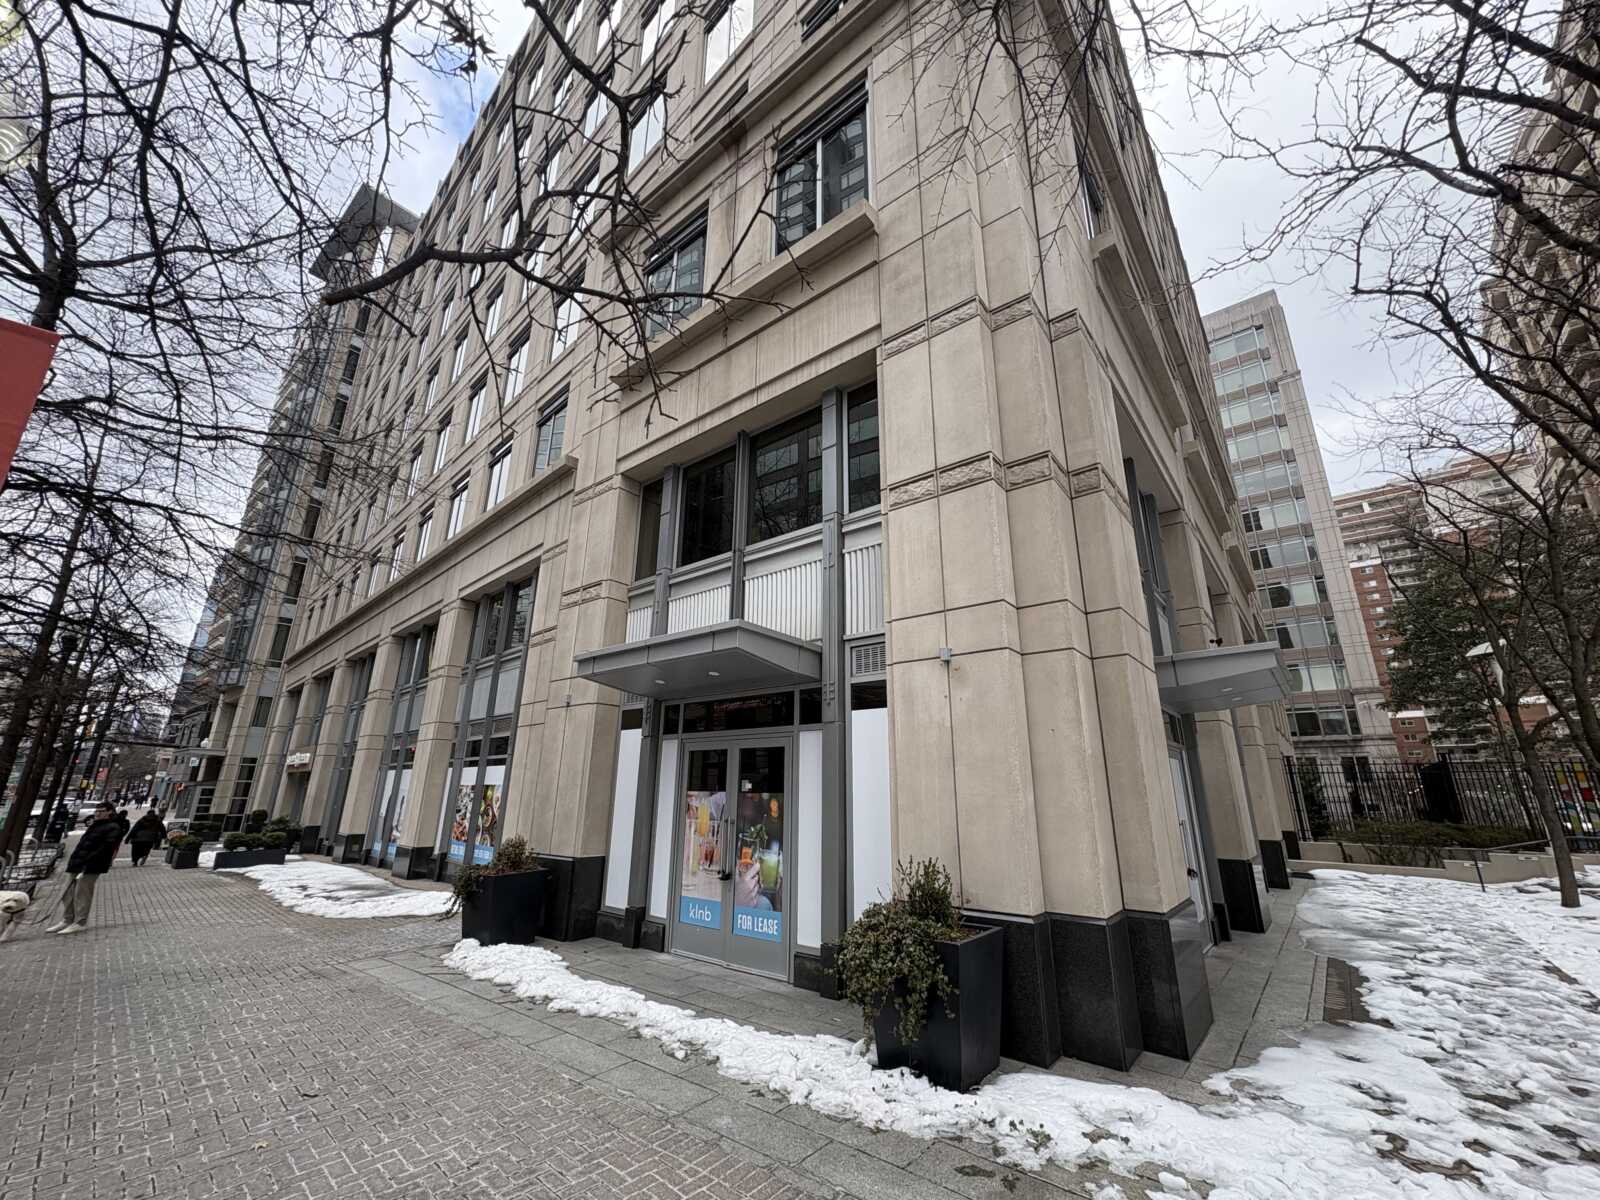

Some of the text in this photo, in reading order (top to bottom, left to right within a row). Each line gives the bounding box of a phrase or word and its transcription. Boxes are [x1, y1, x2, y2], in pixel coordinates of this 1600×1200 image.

[689, 903, 712, 921] klnb
[737, 914, 778, 935] FOR LEASE
